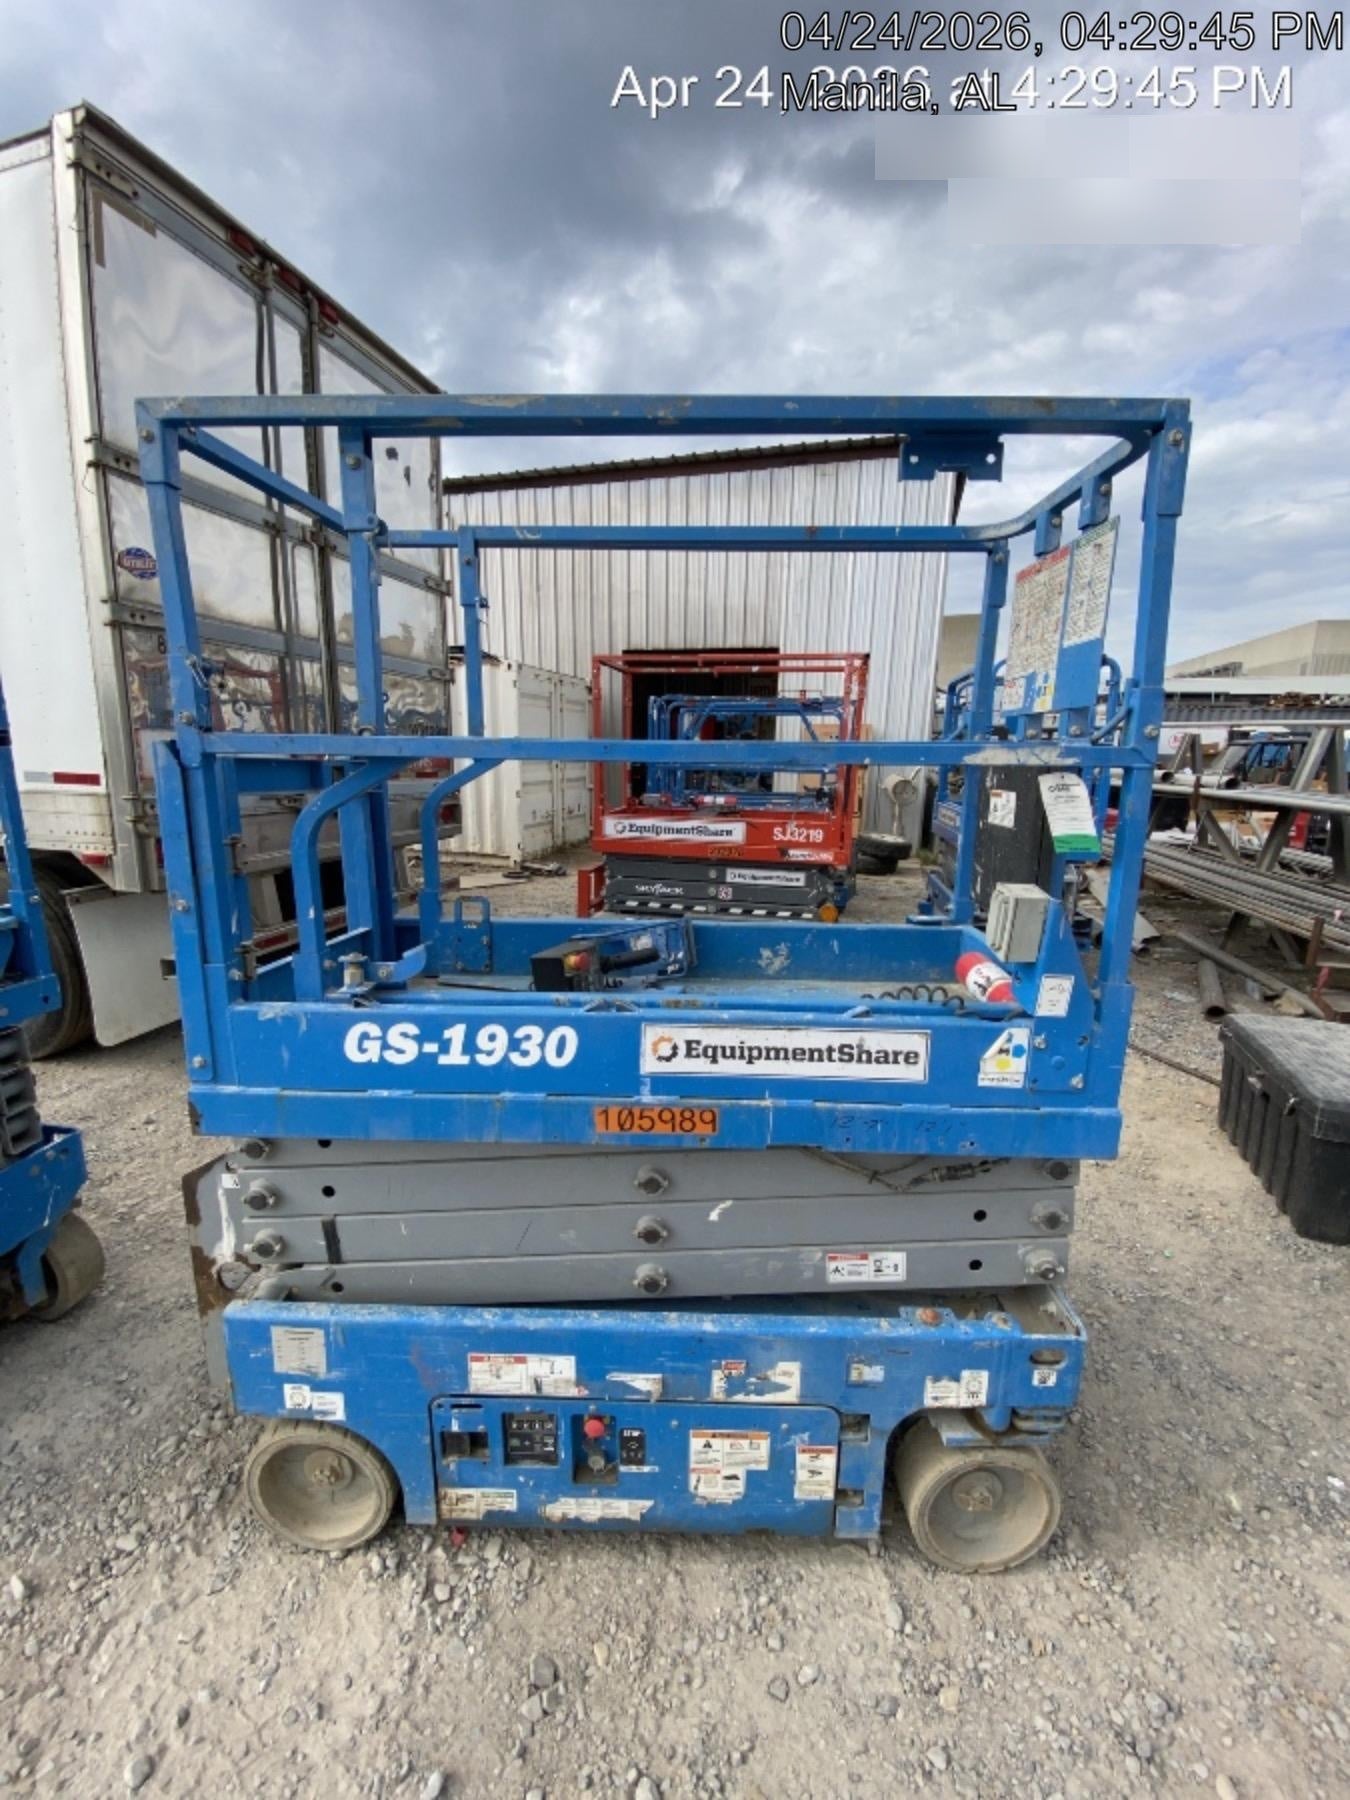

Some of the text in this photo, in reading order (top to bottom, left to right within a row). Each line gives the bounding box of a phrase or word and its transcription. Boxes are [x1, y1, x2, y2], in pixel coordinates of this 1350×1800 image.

[628, 823, 734, 838] EquipmentShare
[773, 826, 824, 843] SJ3219
[343, 1021, 578, 1068] GS-1930
[683, 1038, 920, 1066] EquipmentShare
[597, 1107, 718, 1134] 105989
